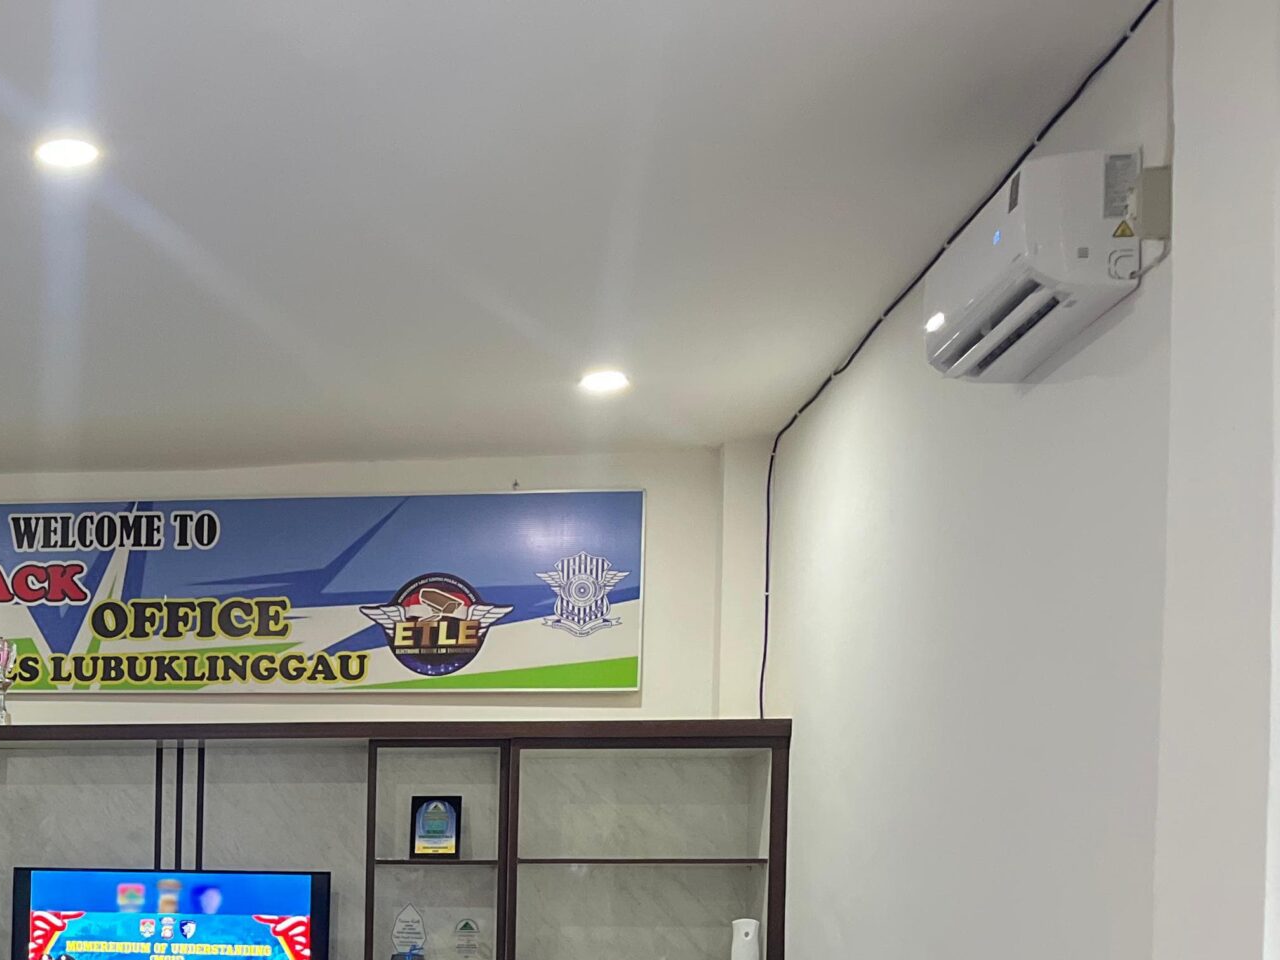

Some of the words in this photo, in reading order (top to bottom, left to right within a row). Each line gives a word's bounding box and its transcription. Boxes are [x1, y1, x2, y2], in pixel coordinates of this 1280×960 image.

[10, 513, 163, 549] WELCOME
[174, 512, 218, 547] TO
[91, 599, 289, 639] OFFICE
[394, 620, 479, 646] ETLE
[50, 654, 368, 682] LUBUKLINGGAU
[153, 942, 168, 954] OF
[171, 943, 272, 956] UNDERSTANDING
